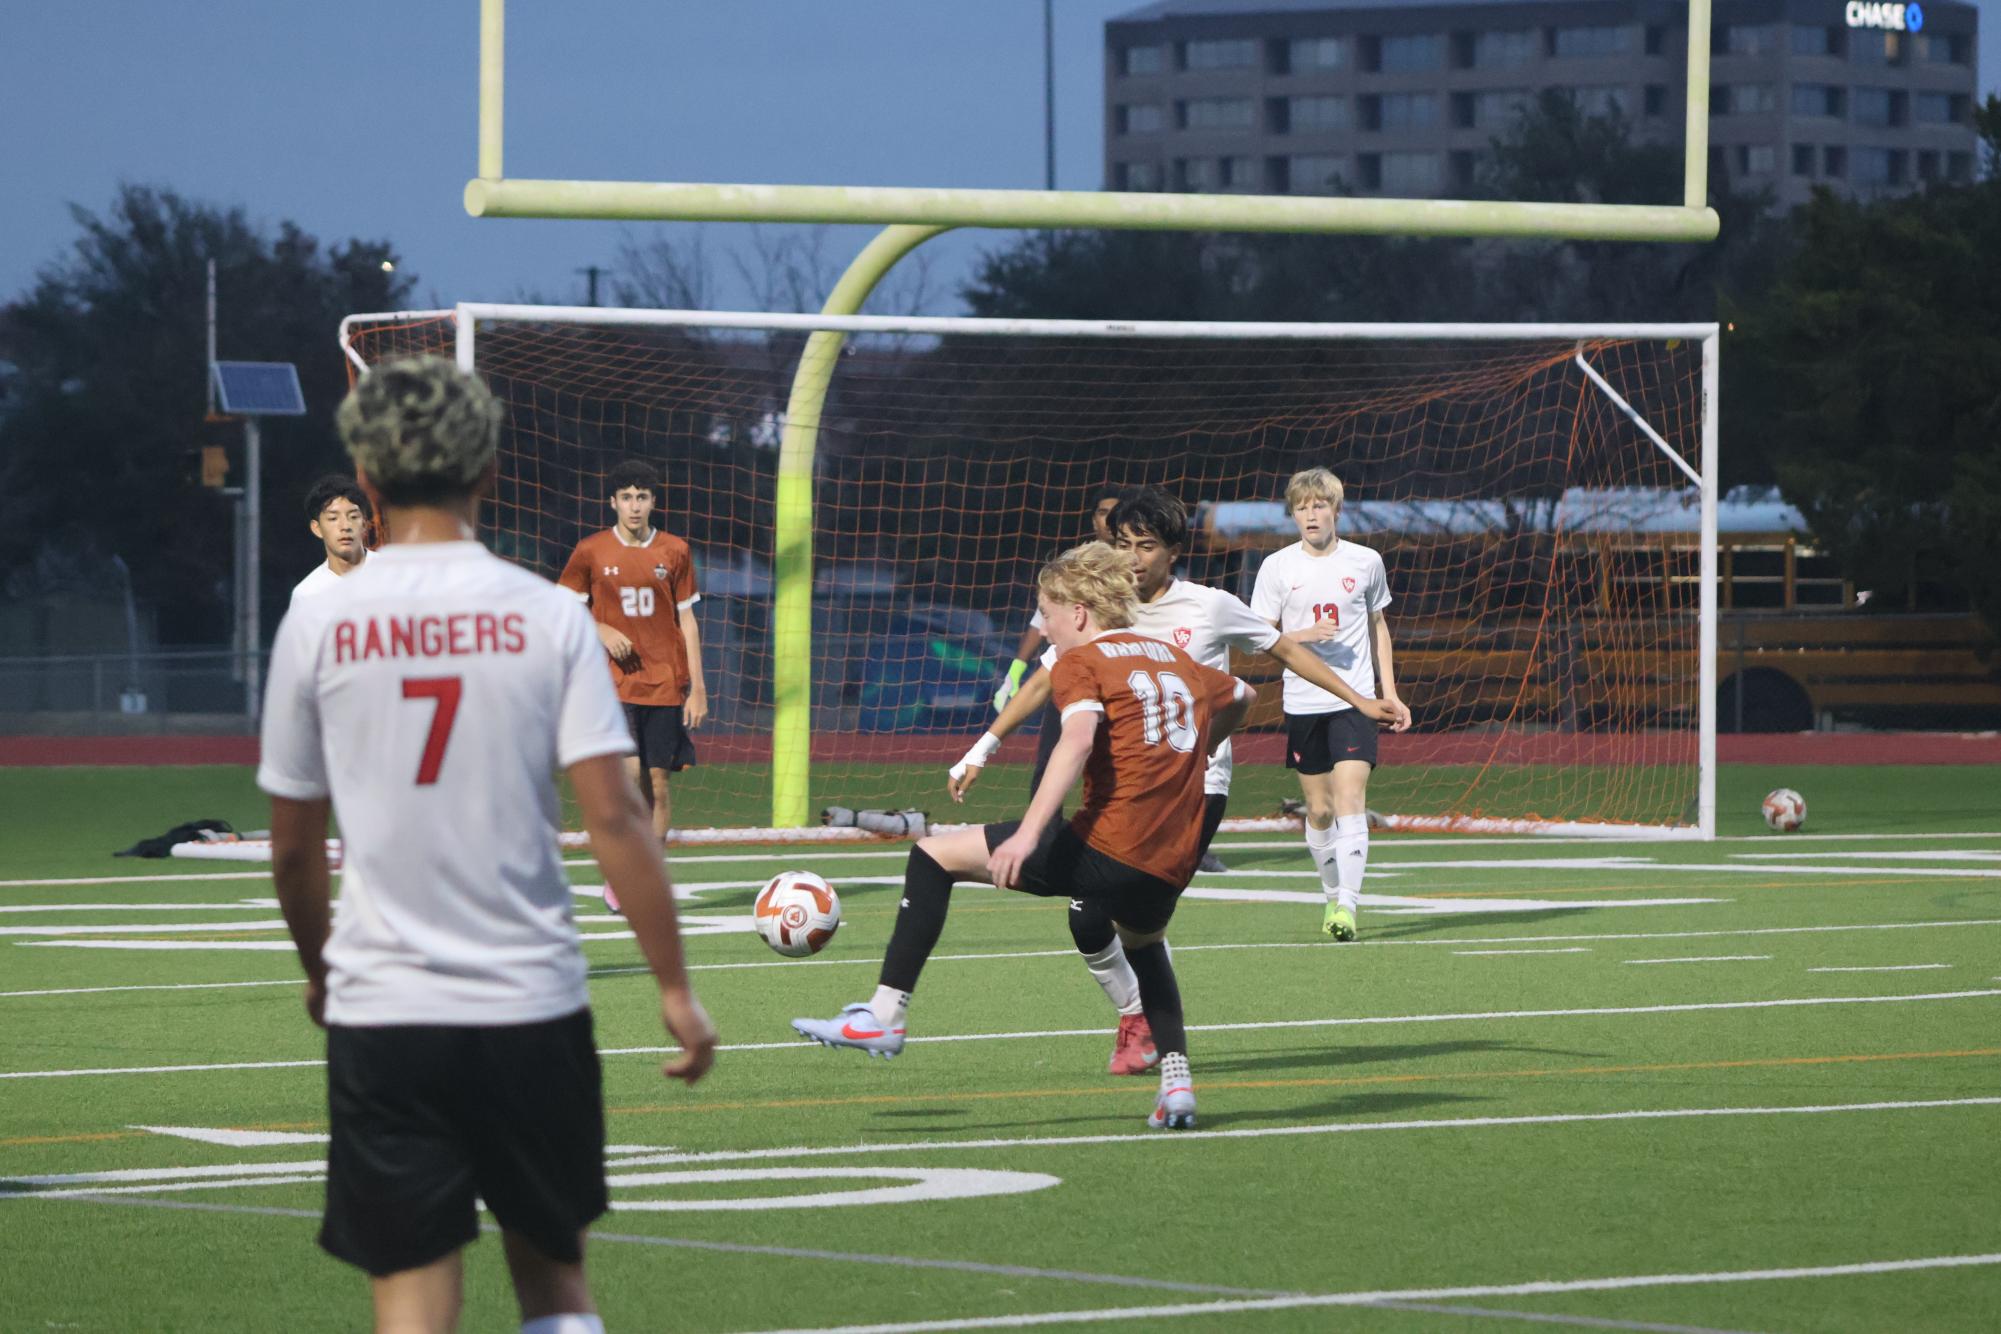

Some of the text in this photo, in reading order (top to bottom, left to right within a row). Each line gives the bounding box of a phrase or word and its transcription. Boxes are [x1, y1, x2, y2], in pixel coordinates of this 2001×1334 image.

[1845, 2, 1905, 30] CHASE
[620, 586, 655, 617] 20
[1312, 603, 1339, 627] 13
[335, 612, 526, 664] RANGERS
[402, 674, 463, 786] 7
[1127, 670, 1198, 753] 10
